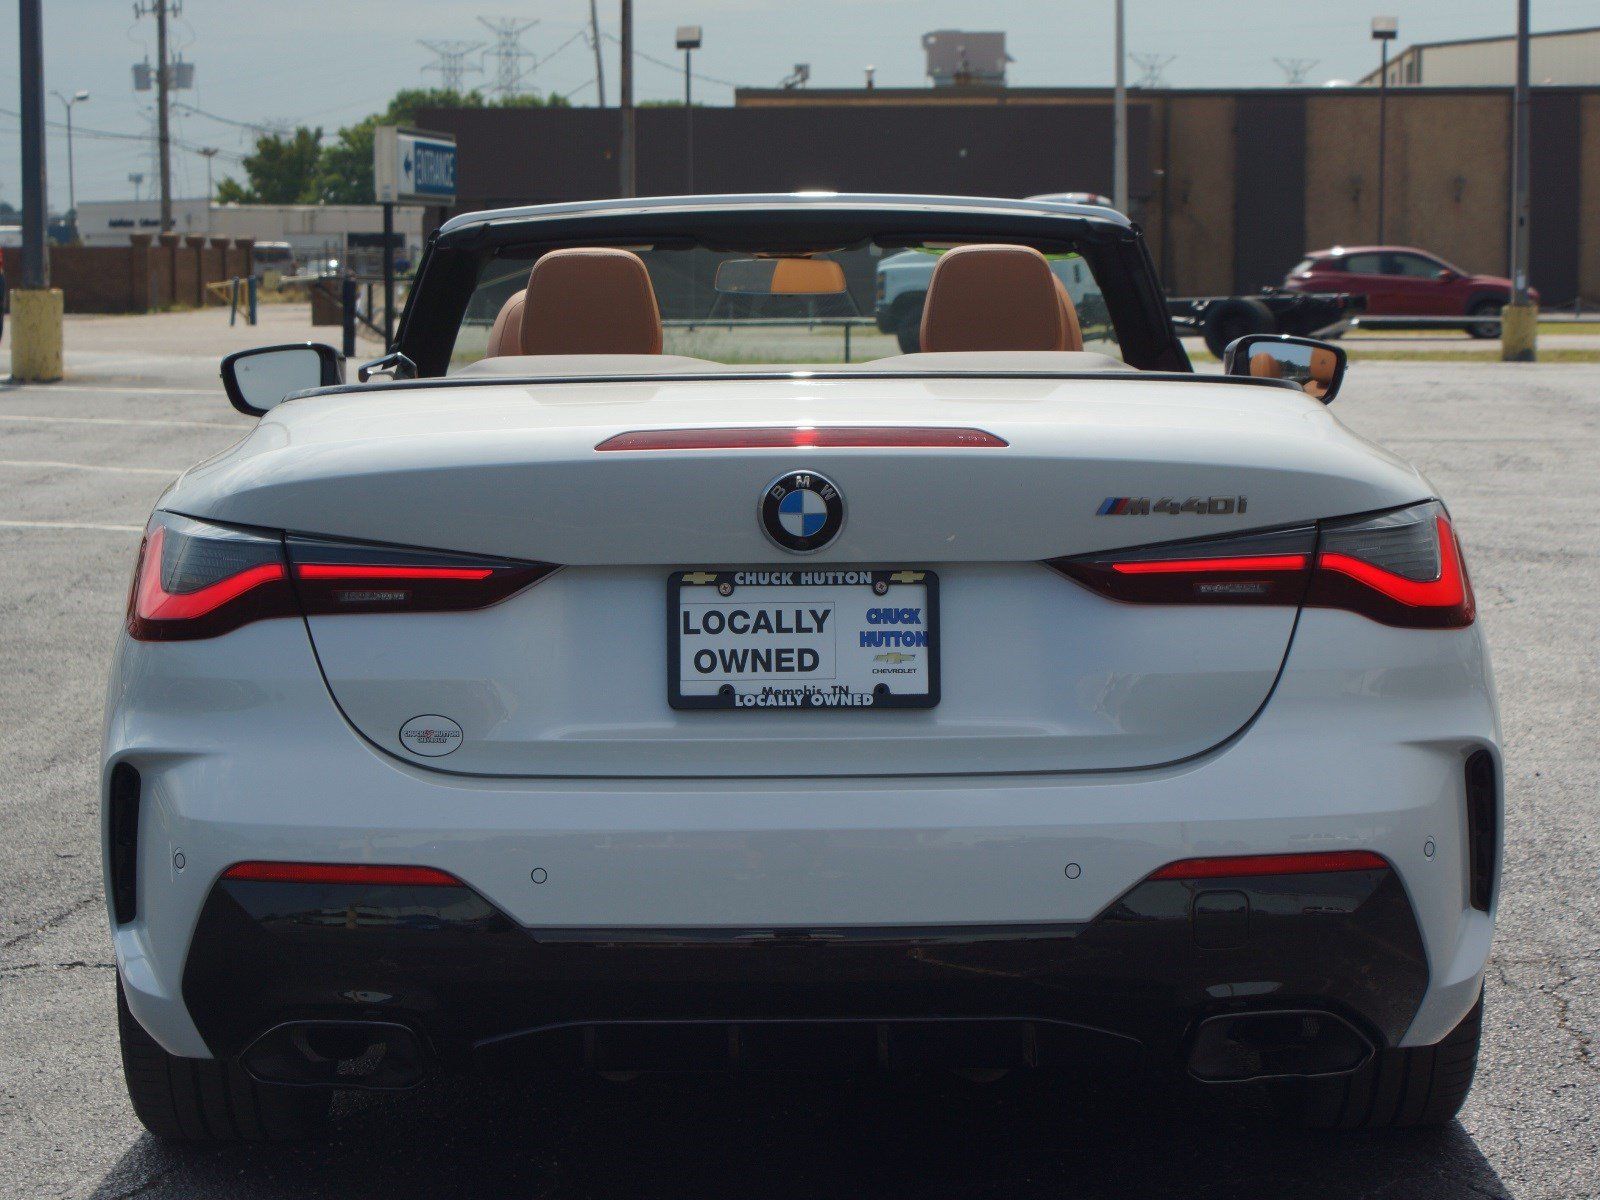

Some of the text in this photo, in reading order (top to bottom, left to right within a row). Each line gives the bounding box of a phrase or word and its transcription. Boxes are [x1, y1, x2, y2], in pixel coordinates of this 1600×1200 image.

[416, 149, 454, 187] ENTRANCE
[769, 475, 837, 501] BMW
[1115, 495, 1248, 516] M440i
[734, 571, 872, 585] CHUCK HUTTON
[683, 609, 831, 635] LOCALLY
[866, 608, 921, 625] CHUCK
[860, 631, 928, 648] HUTTON
[693, 648, 820, 674] OWNED
[735, 693, 874, 707] LOCALLY OWNED
[831, 685, 849, 696] TN
